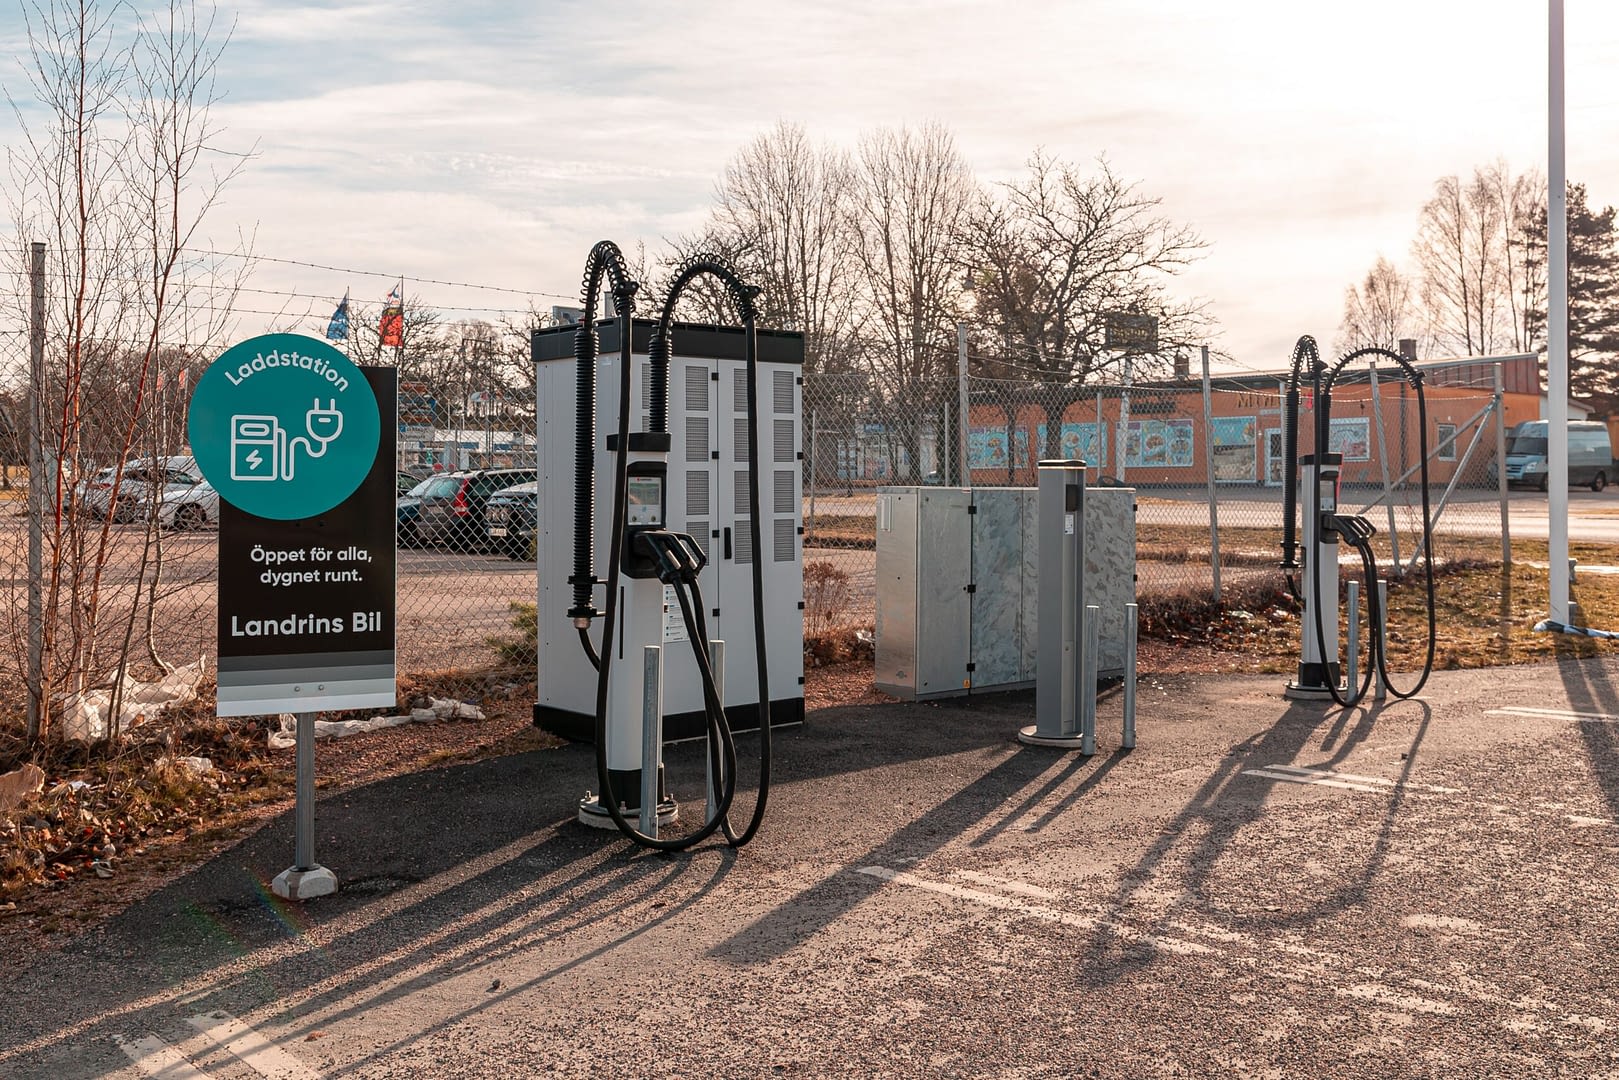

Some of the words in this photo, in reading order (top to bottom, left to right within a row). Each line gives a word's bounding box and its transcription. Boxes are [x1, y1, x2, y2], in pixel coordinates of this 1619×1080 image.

[224, 350, 349, 392] Laddstation
[250, 545, 306, 565] Öppet
[310, 547, 334, 562] för
[337, 546, 373, 563] alla,
[260, 569, 321, 586] dygnet
[324, 569, 363, 583] runt.
[231, 614, 344, 637] Landrins
[352, 611, 381, 633] Bil
